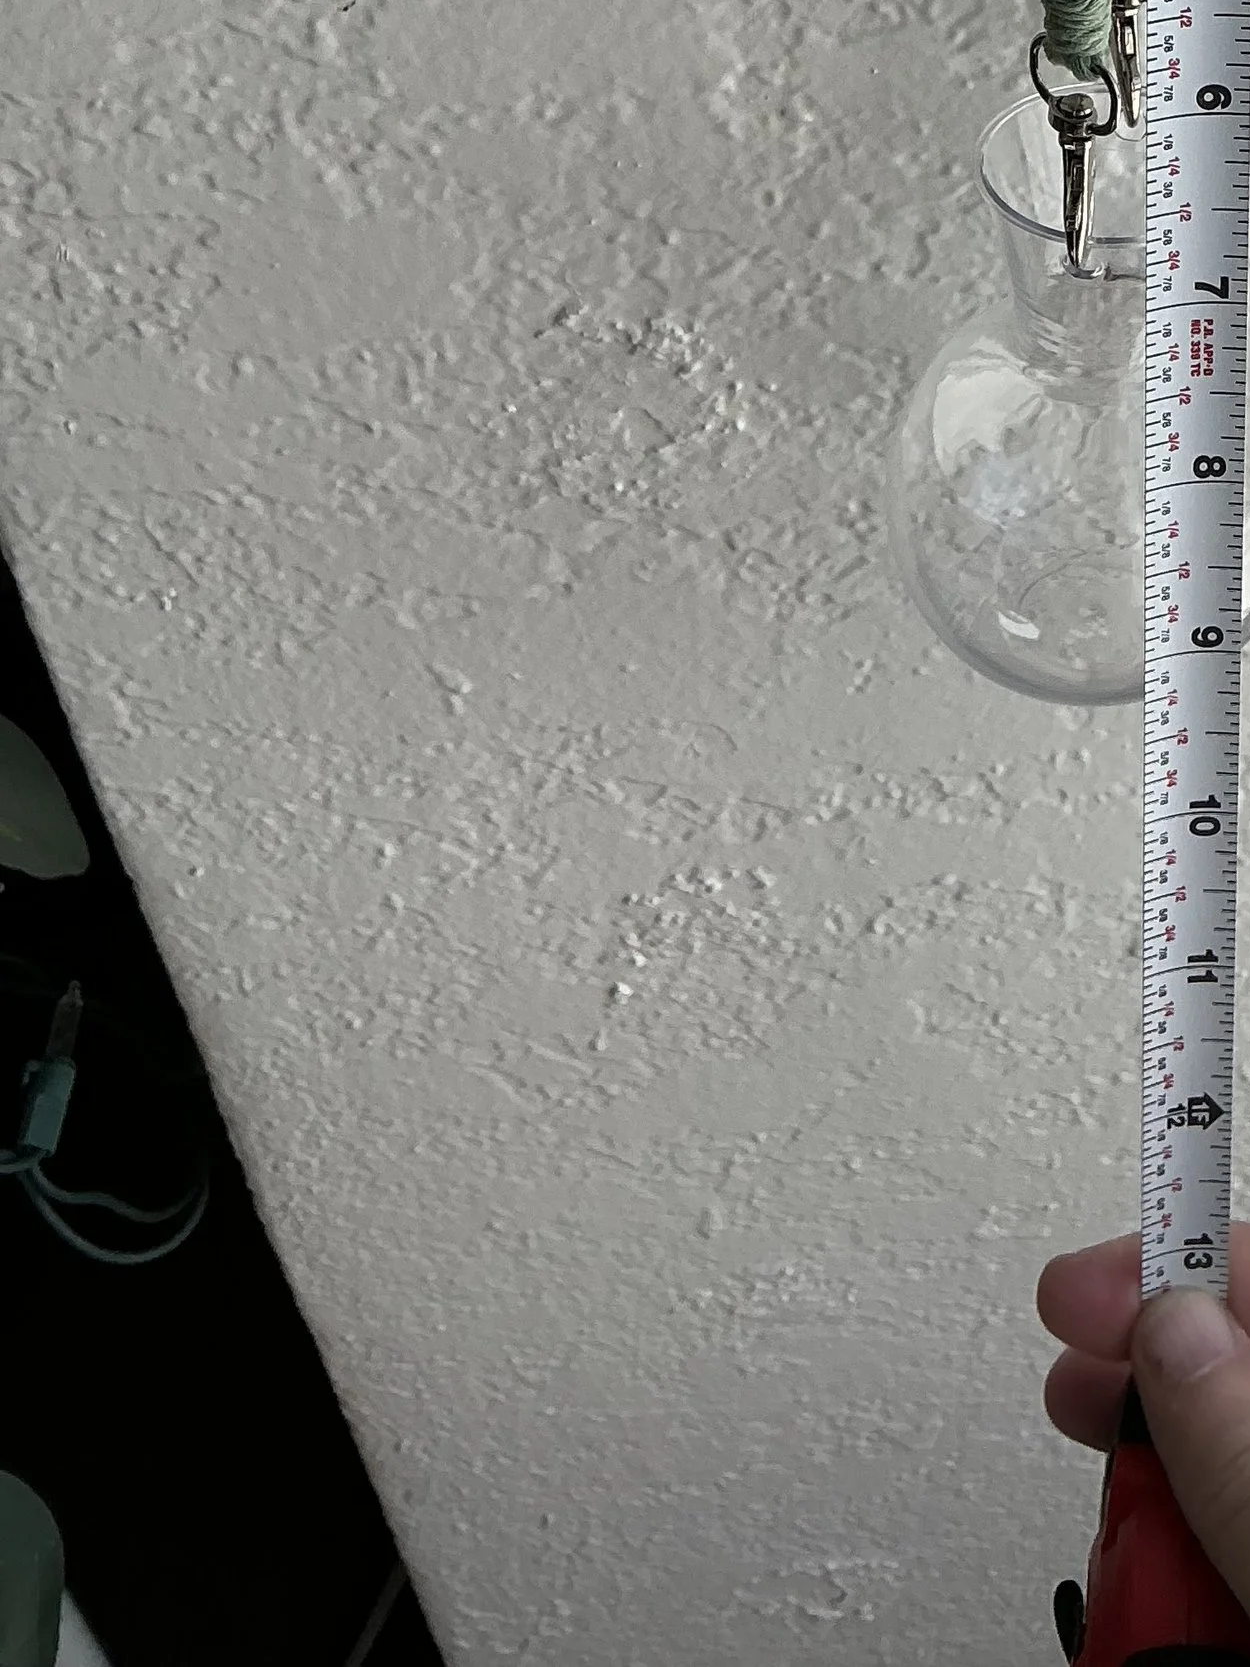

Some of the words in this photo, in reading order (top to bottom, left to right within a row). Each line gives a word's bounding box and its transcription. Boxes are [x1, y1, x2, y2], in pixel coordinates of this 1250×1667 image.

[1180, 7, 1192, 28] 1/2
[1164, 35, 1173, 53] 5/8
[1168, 58, 1180, 79] 3/4
[1164, 85, 1173, 102] 7/8
[1196, 84, 1232, 110] 6
[1163, 134, 1173, 151] 1/8
[1168, 156, 1180, 177] 1/4
[1163, 181, 1172, 199] 3/8
[1179, 202, 1191, 222] 1/2
[1163, 229, 1172, 246] 5/8
[1168, 251, 1180, 270] 3/4
[1162, 276, 1172, 292] 7/8
[1195, 276, 1229, 299] 7
[1162, 322, 1172, 338] 1/8
[1168, 343, 1179, 362] 1/4
[1162, 367, 1171, 383] 3/8
[1190, 362, 1201, 377] TC
[1179, 386, 1190, 405] 1/2
[1162, 412, 1171, 428] 5/8
[1168, 432, 1179, 452] 3/4
[1162, 457, 1171, 472] 7/8
[1193, 455, 1227, 479] 8
[1162, 501, 1171, 516] 1/8
[1168, 520, 1179, 539] 1/4
[1161, 543, 1170, 559] 3/8
[1179, 561, 1190, 580] 1/2
[1167, 605, 1178, 623] 3/4
[1191, 625, 1224, 648] 9
[1167, 689, 1177, 706] 1/4
[1177, 728, 1188, 745] 1/2
[1166, 769, 1177, 788] 3/4
[1189, 794, 1221, 836] 10
[1187, 949, 1218, 985] 11
[1167, 1103, 1186, 1129] 12
[1184, 1233, 1213, 1270] 13
